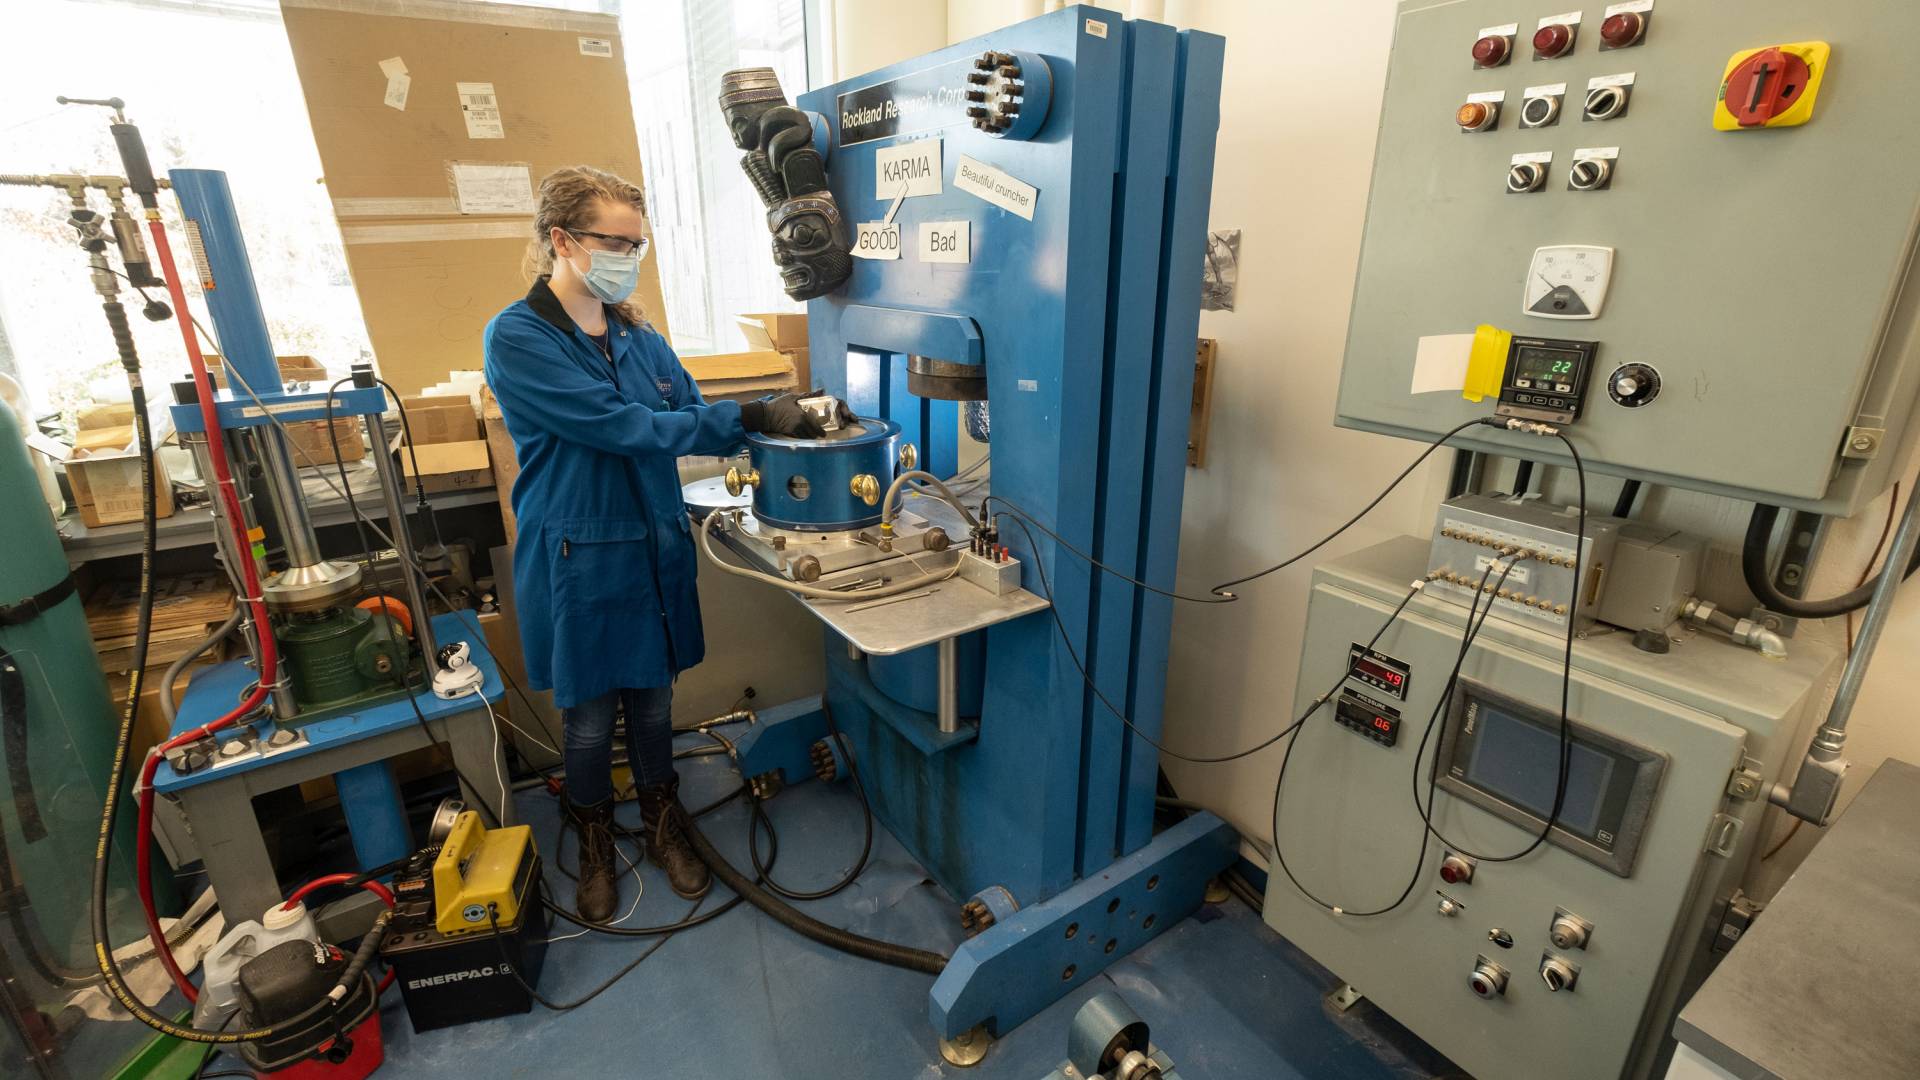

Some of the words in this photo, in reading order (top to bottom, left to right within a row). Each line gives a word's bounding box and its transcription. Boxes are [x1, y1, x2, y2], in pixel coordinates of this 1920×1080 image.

[842, 102, 882, 128] Rockland
[885, 91, 932, 119] Research
[884, 156, 930, 182] KARMA
[962, 165, 994, 190] Beautiful
[995, 183, 1029, 206] cruncher
[860, 231, 898, 249] GOOD
[931, 230, 956, 251] Bad
[1552, 361, 1571, 373] 22
[1374, 652, 1387, 660] RPM
[1386, 671, 1401, 686] 49
[1356, 693, 1386, 710] PRESSURE
[408, 966, 494, 989] ENERPAC
